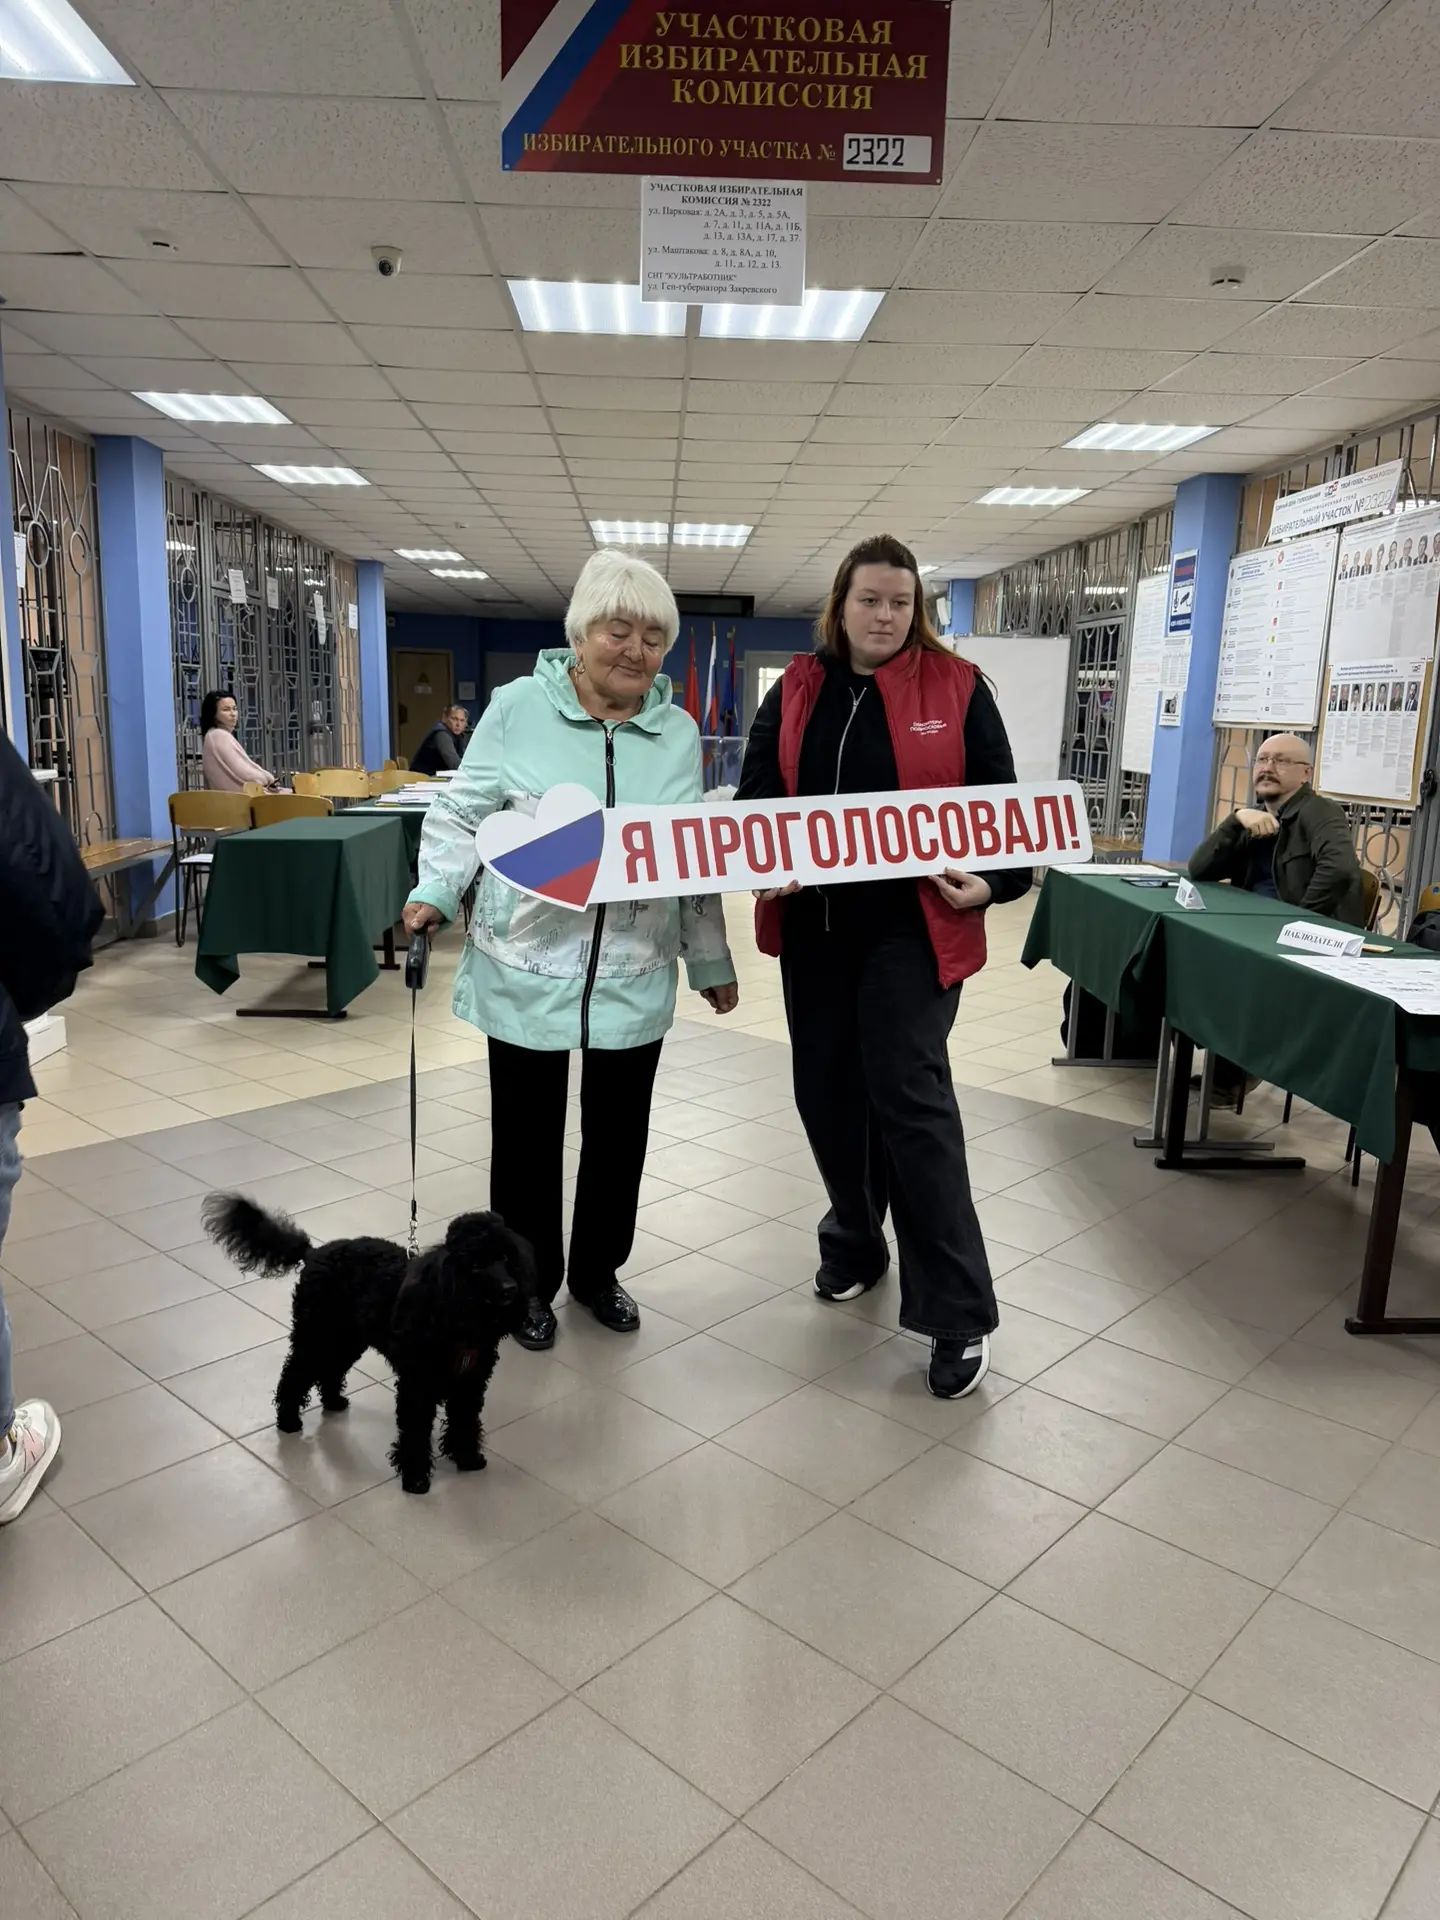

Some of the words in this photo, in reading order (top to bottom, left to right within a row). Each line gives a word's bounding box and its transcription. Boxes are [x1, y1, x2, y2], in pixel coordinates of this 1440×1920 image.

[655, 12, 894, 45] УЧАСТКОВАЯ
[619, 44, 929, 79] ИЗБИРАТЕЛЬНАЯ
[672, 79, 873, 110] КОМИССИЯ
[523, 132, 714, 157] ИЗБИРАТЕЛЬНОГО
[719, 139, 813, 160] УЧАСТКА
[817, 144, 837, 161] №
[846, 138, 905, 166] 2322
[650, 183, 717, 193] УЧАСТКОВАЯ
[719, 184, 803, 197] ИЗБИРАТЕЛЬНАЯ
[682, 195, 739, 206] КОМИССИЯ
[740, 197, 750, 206] №
[752, 198, 772, 207] 2322
[648, 208, 660, 217] ул.
[647, 271, 663, 280] СНТ
[730, 284, 778, 294] Закревского
[1321, 505, 1353, 522] УЧАСТОК
[621, 821, 659, 884] Я
[672, 794, 1081, 880] ПРОГОЛОСОВАЛ!
[1284, 929, 1344, 949] НАБЛЮДАТЕЛИ
